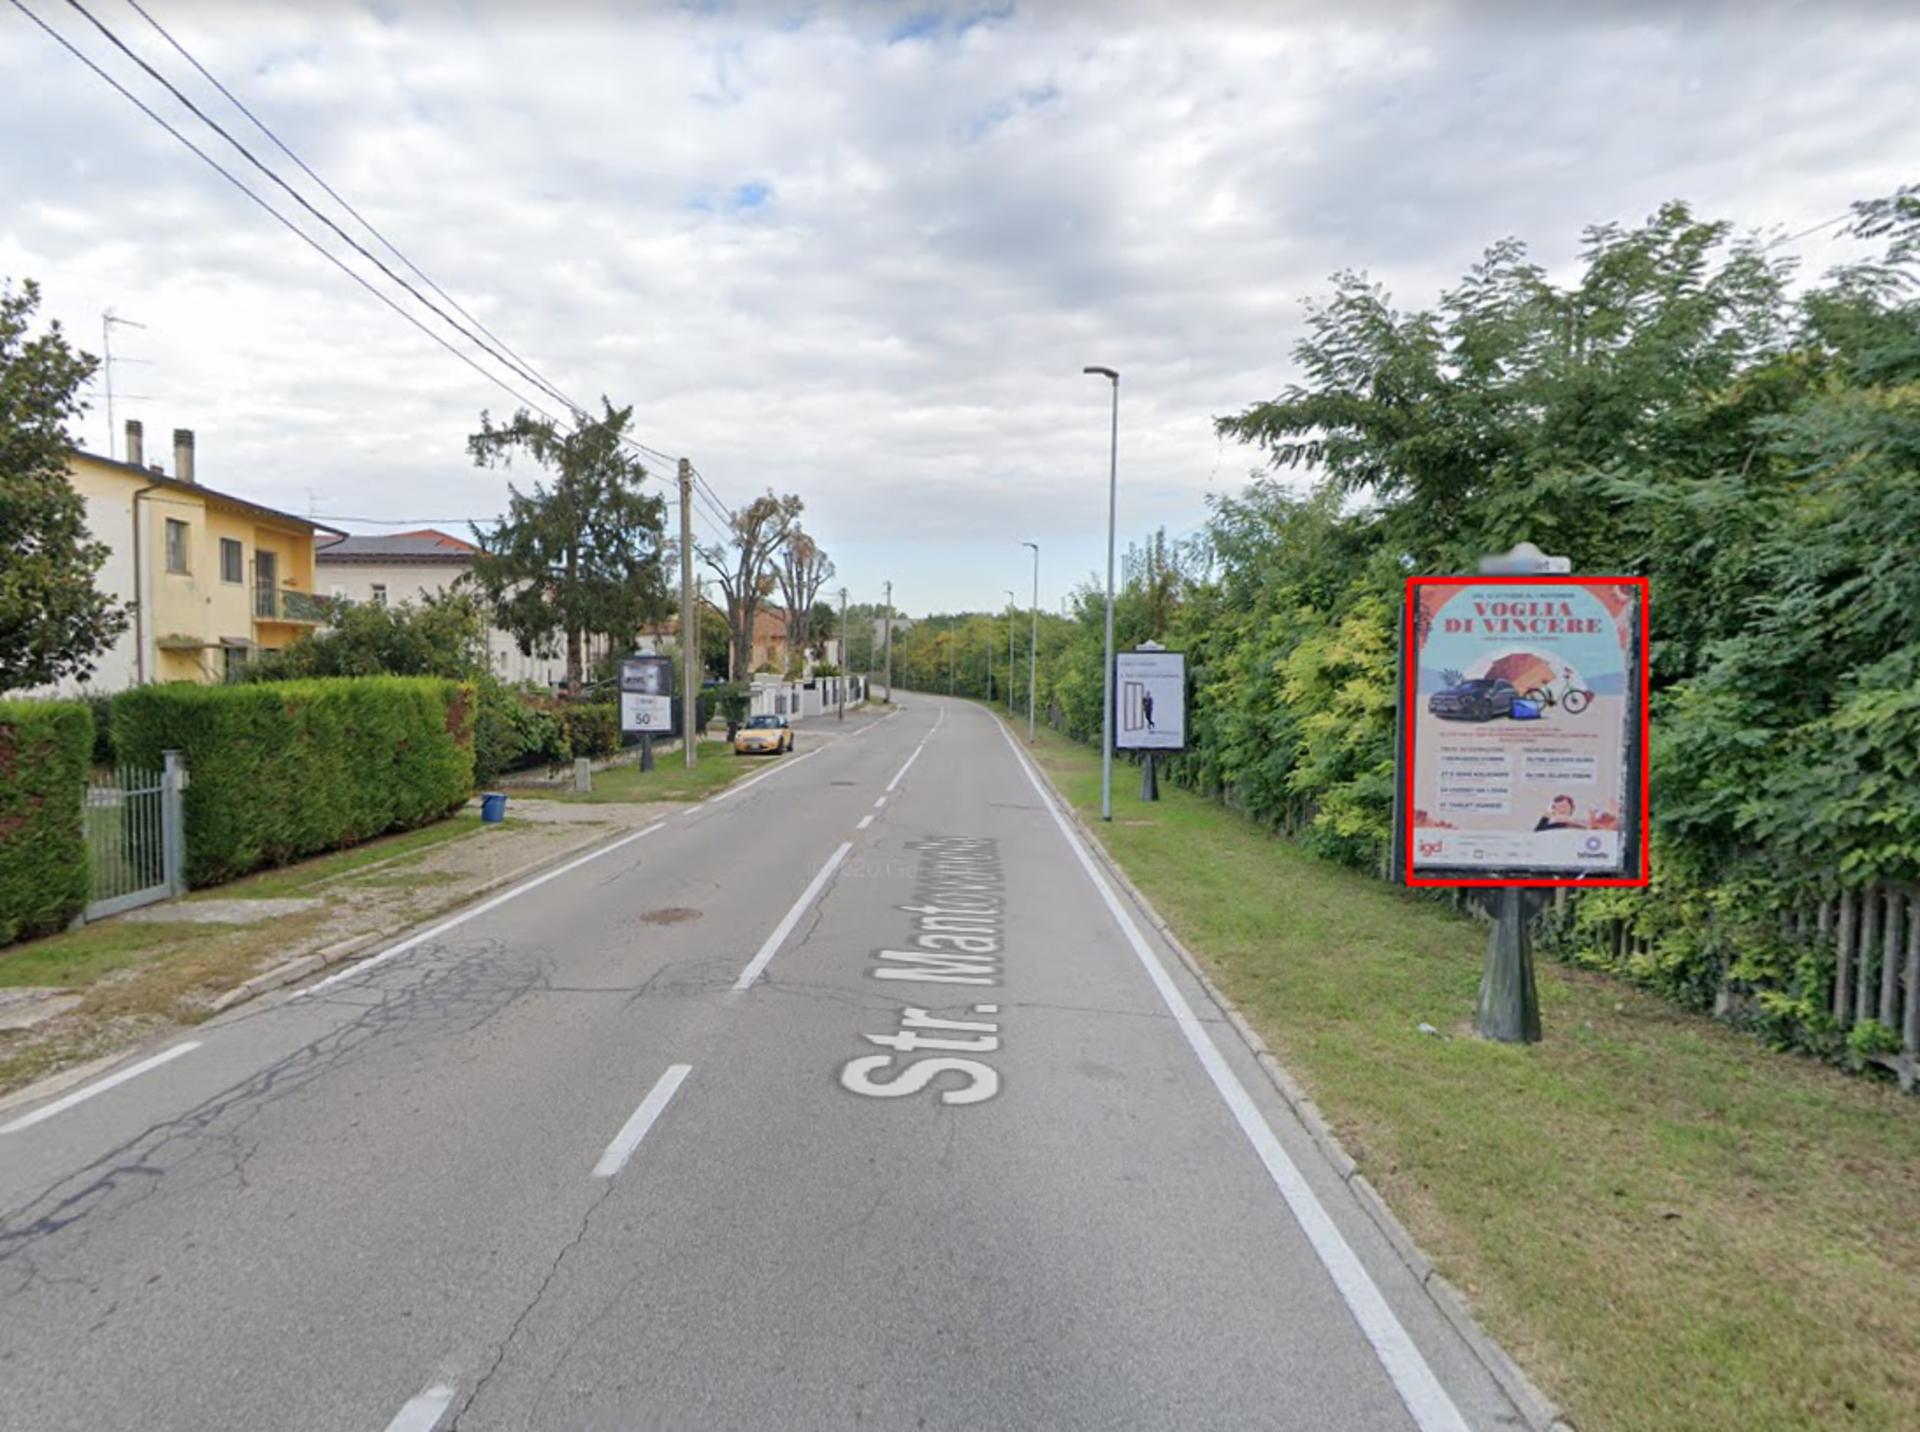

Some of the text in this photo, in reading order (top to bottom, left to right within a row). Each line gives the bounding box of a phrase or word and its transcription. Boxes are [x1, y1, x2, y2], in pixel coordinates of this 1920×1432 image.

[1474, 602, 1572, 616] VOGLIA
[1445, 619, 1602, 633] DI VINCERE
